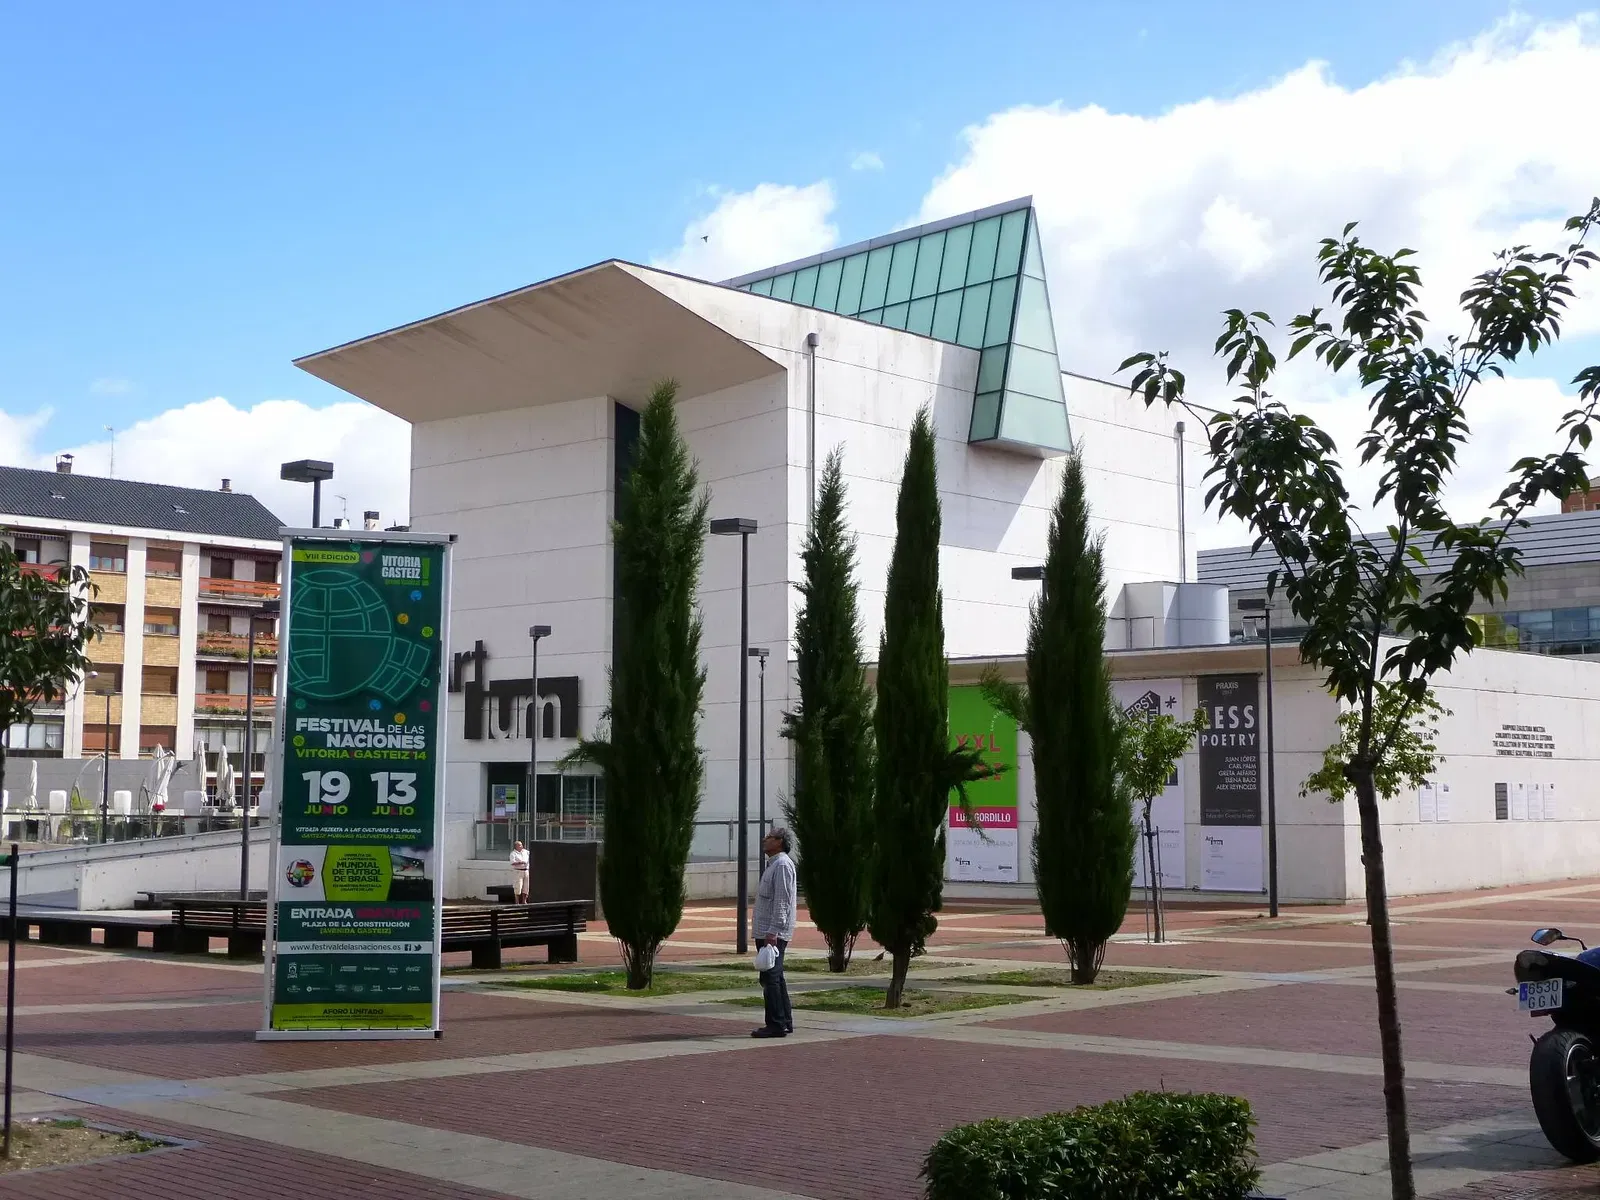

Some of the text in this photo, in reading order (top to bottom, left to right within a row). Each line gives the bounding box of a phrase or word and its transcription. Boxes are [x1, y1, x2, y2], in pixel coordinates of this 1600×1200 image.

[321, 552, 357, 561] EDICIÓN
[382, 555, 421, 567] VITORIA
[381, 567, 420, 579] GASTEIZ
[1215, 681, 1239, 690] PRAXIS
[1125, 692, 1154, 721] FIRST
[295, 717, 425, 735] FESTIVAL DE LAS
[326, 733, 426, 750] NACIONES
[1201, 733, 1256, 747] POETRY
[302, 770, 417, 805] 19 13
[303, 805, 415, 816] JUNIO JULIO
[974, 811, 1011, 822] GORDILLO
[347, 875, 382, 883] BRASIL
[290, 908, 354, 919] ENTRADA
[352, 920, 410, 928] CONSTITUCIÓN
[290, 943, 401, 951] www.festivaldelasnaciones.es
[1528, 980, 1559, 995] 6530
